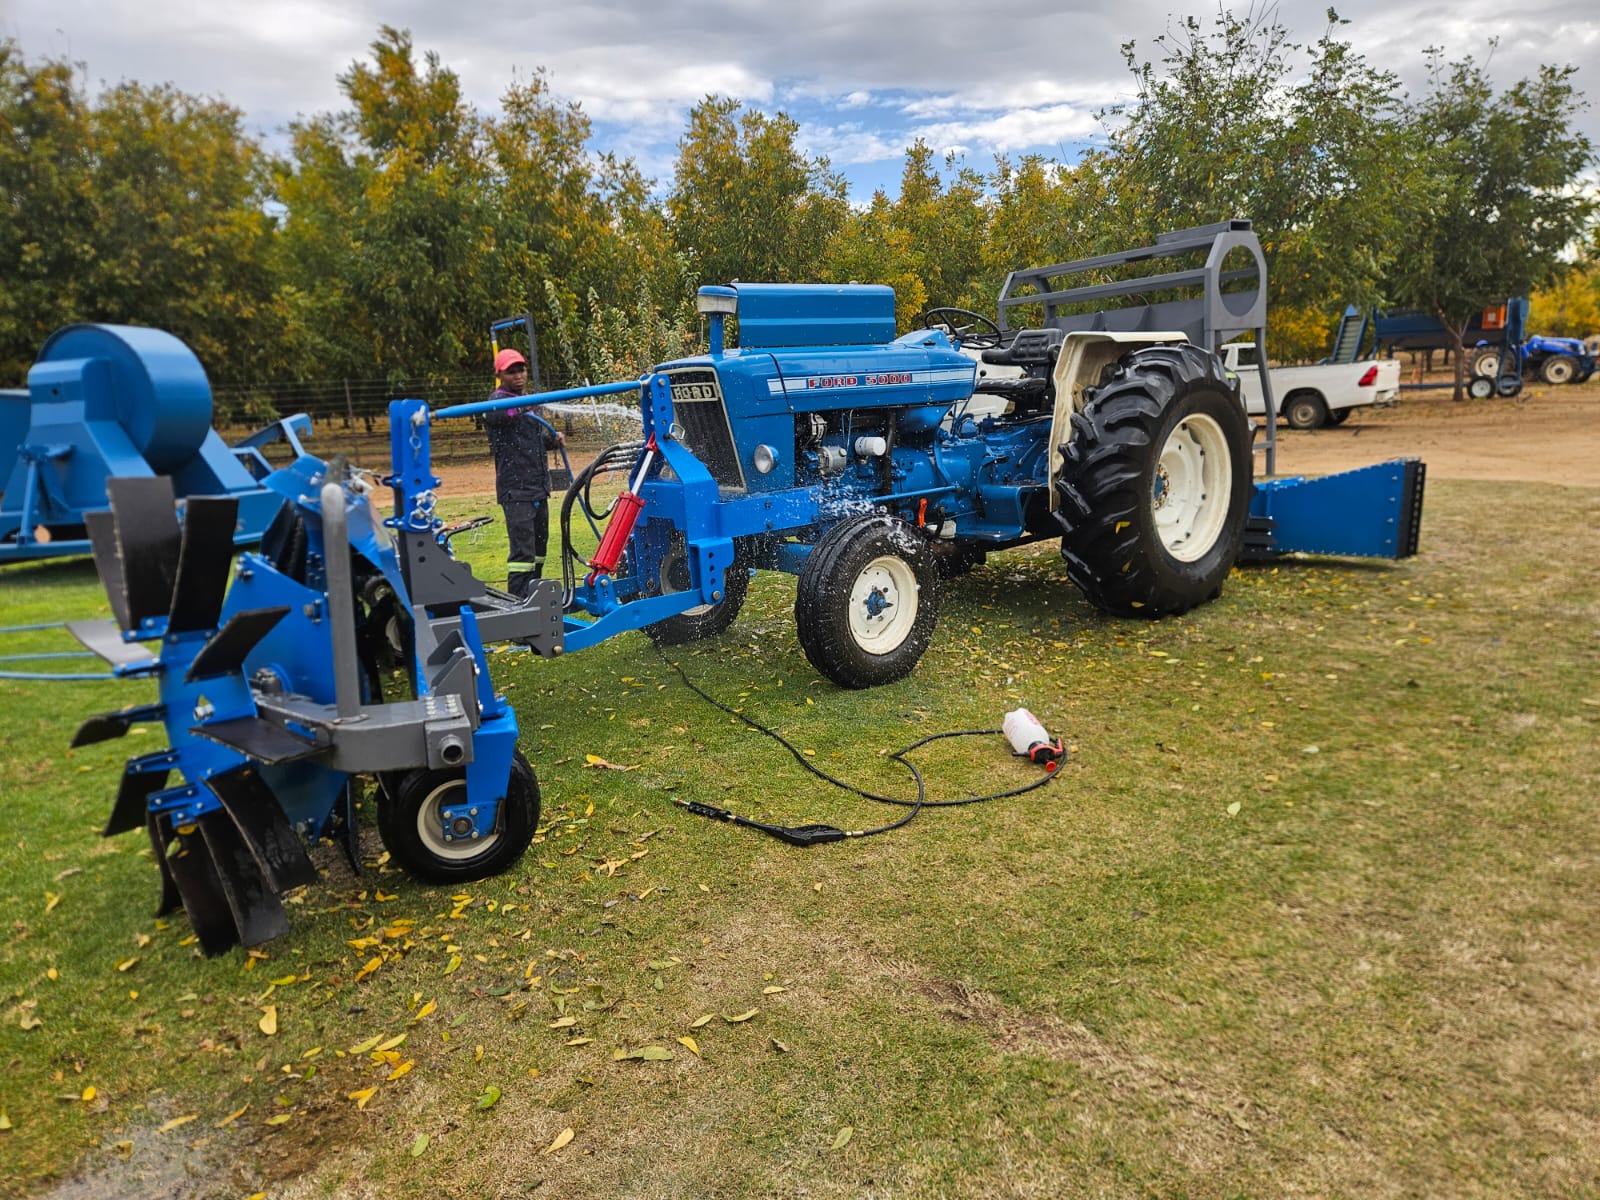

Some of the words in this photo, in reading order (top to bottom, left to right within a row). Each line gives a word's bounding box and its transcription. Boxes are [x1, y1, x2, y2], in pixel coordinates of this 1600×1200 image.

[807, 376, 858, 389] FORD
[865, 373, 911, 385] 5000
[673, 386, 713, 400] FORD
